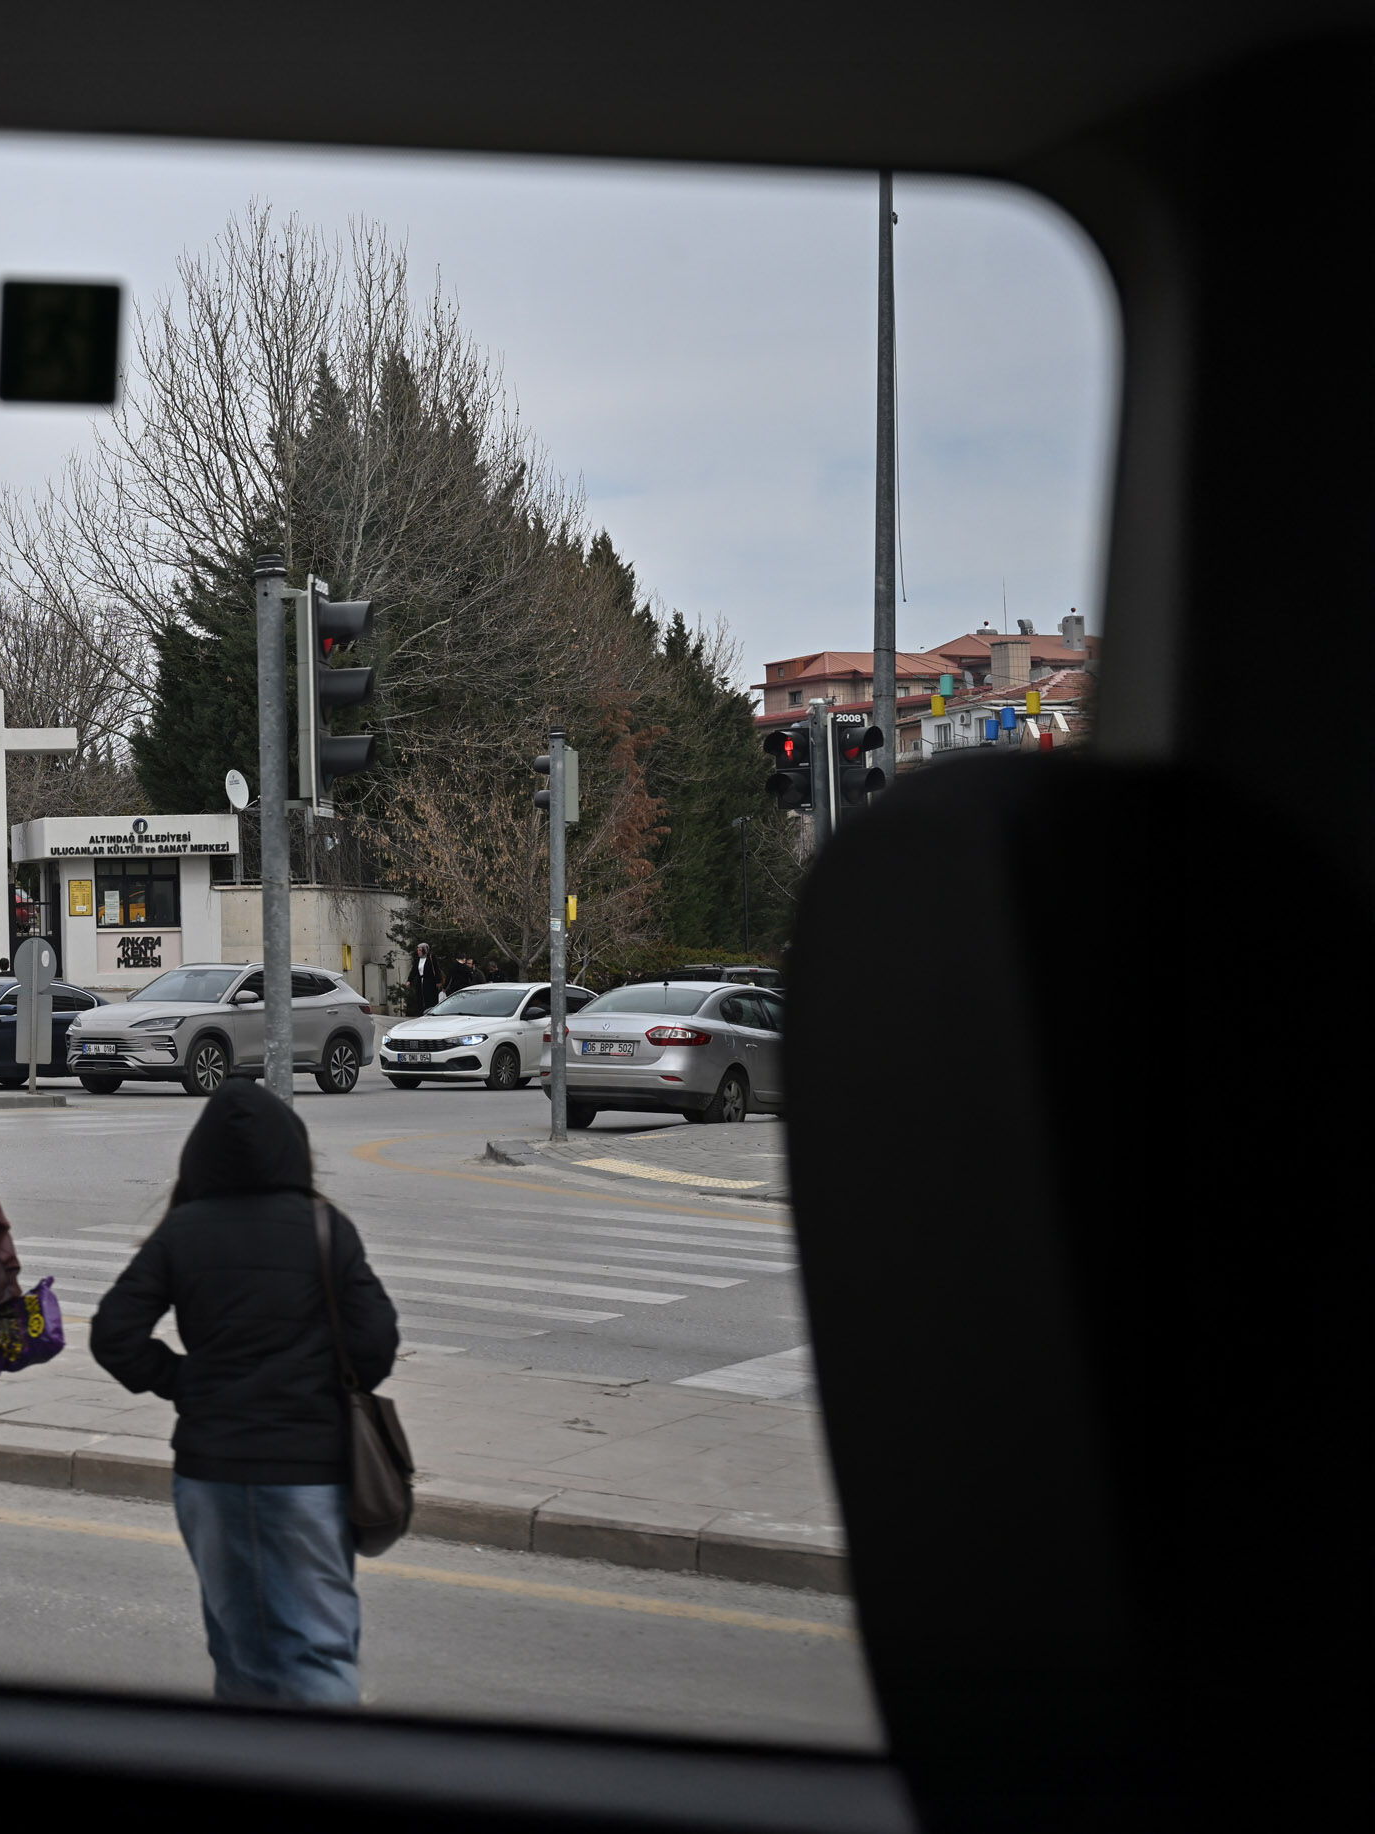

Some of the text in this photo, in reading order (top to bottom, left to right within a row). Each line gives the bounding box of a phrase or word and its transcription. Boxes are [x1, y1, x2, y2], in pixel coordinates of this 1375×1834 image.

[836, 713, 862, 723] 2008
[89, 831, 192, 845] ALTINDAĞ BELEDİYESİ
[50, 845, 105, 856] ULUCANLAR
[107, 843, 143, 855] KÜLTÜR
[158, 844, 187, 854] SANAT
[190, 841, 230, 853] MERKEZİ
[116, 936, 162, 949] ANKARA
[587, 1042, 633, 1053] 06 BPP 502
